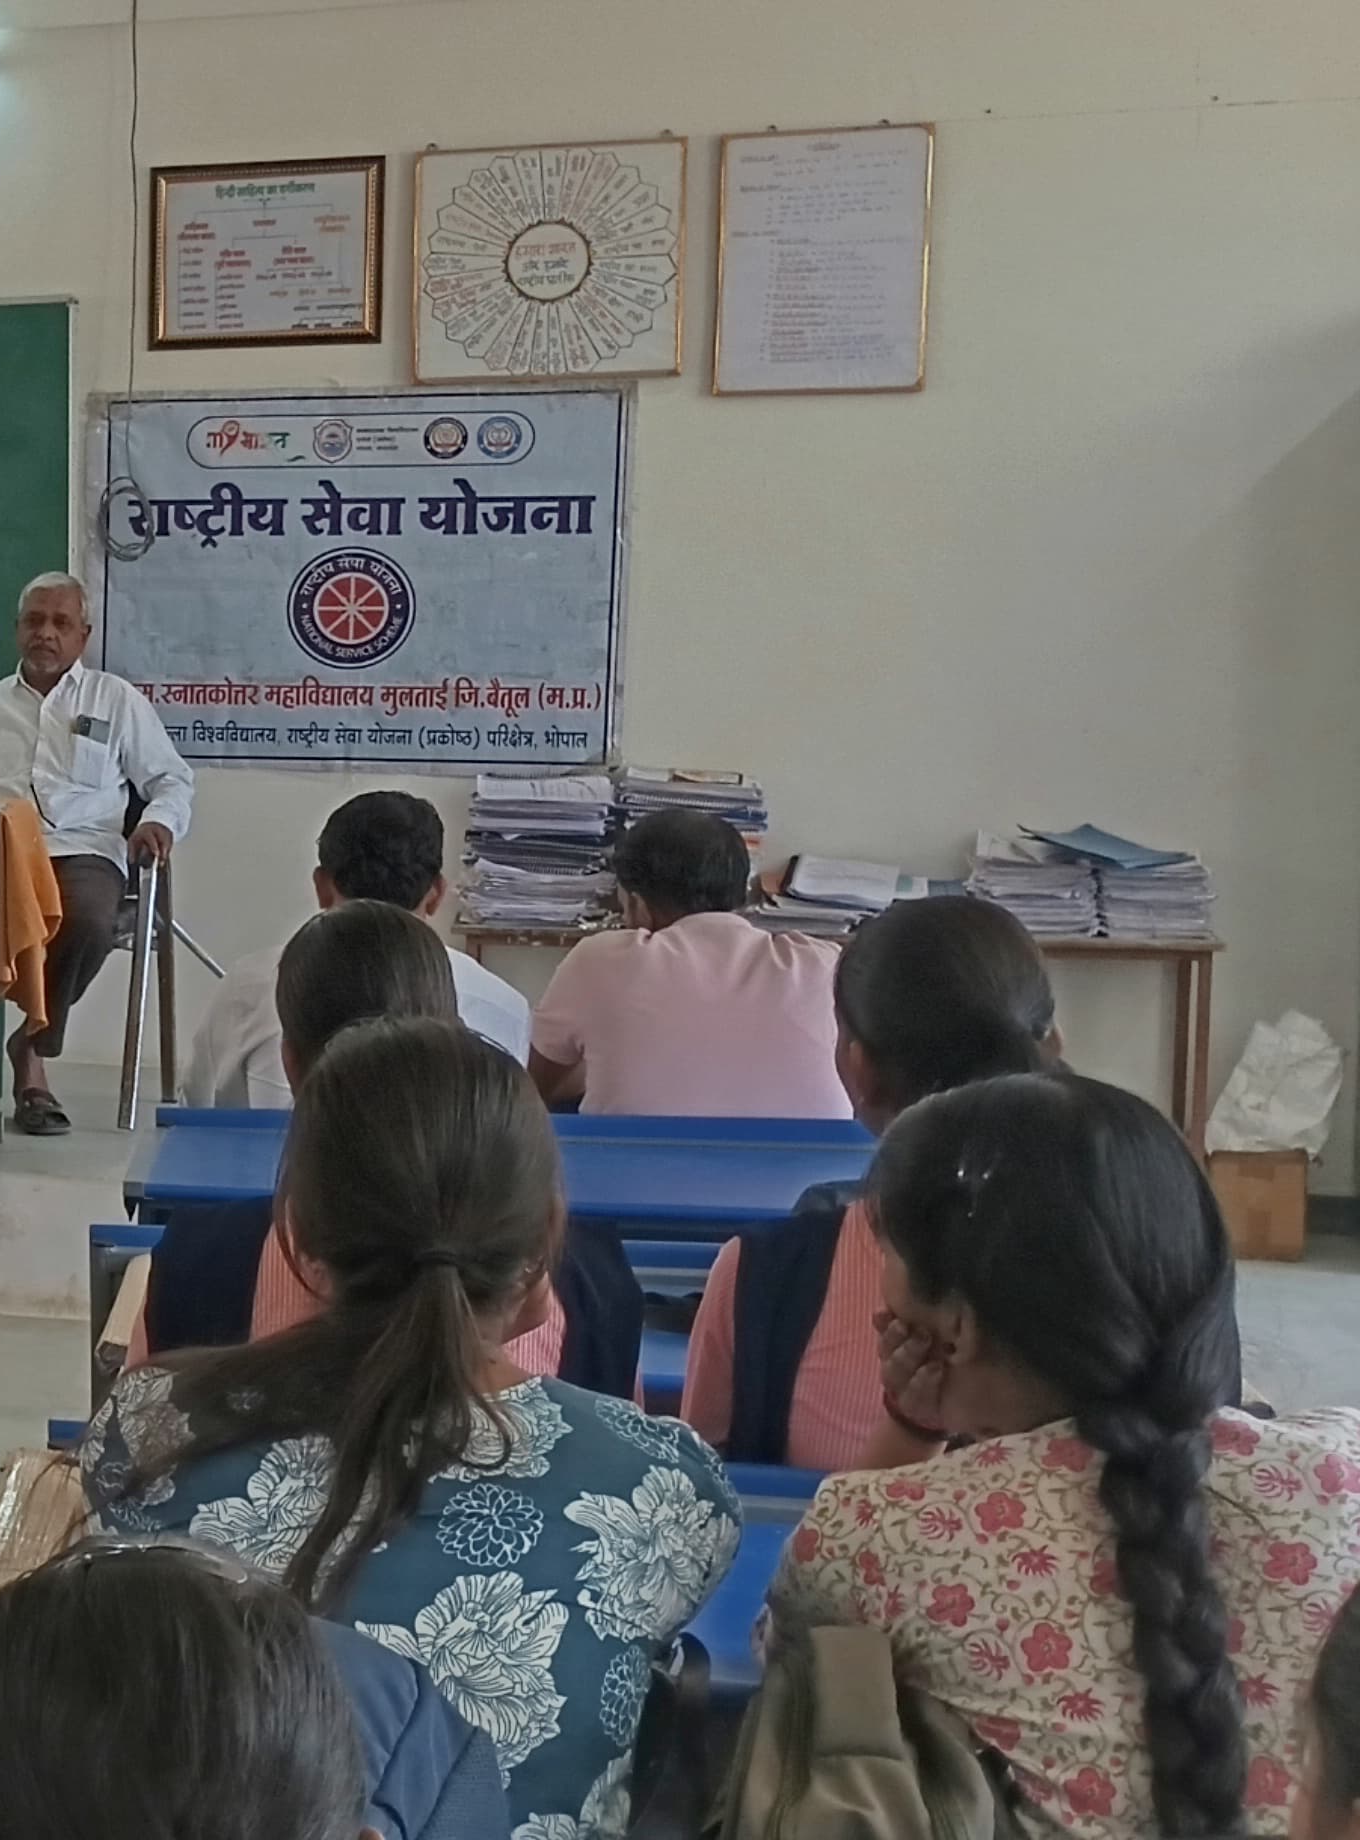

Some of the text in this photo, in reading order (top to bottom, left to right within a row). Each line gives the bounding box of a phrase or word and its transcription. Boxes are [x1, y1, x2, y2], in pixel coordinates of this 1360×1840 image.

[127, 478, 597, 549] राष्ट्रीय सेवा योजना
[265, 675, 375, 709] महाविद्यालय
[380, 678, 449, 717] मुलताई
[538, 681, 601, 712] (म.प्र.)
[192, 720, 280, 745] विश्वविद्यालय,
[287, 721, 330, 749] राष्ट्रीय
[335, 722, 362, 744] सेवा
[368, 722, 412, 745] योजना
[418, 723, 480, 750] (प्रकोष्ठ)
[487, 723, 537, 750] परिक्षेत्र,
[544, 724, 588, 748] भोपाल
